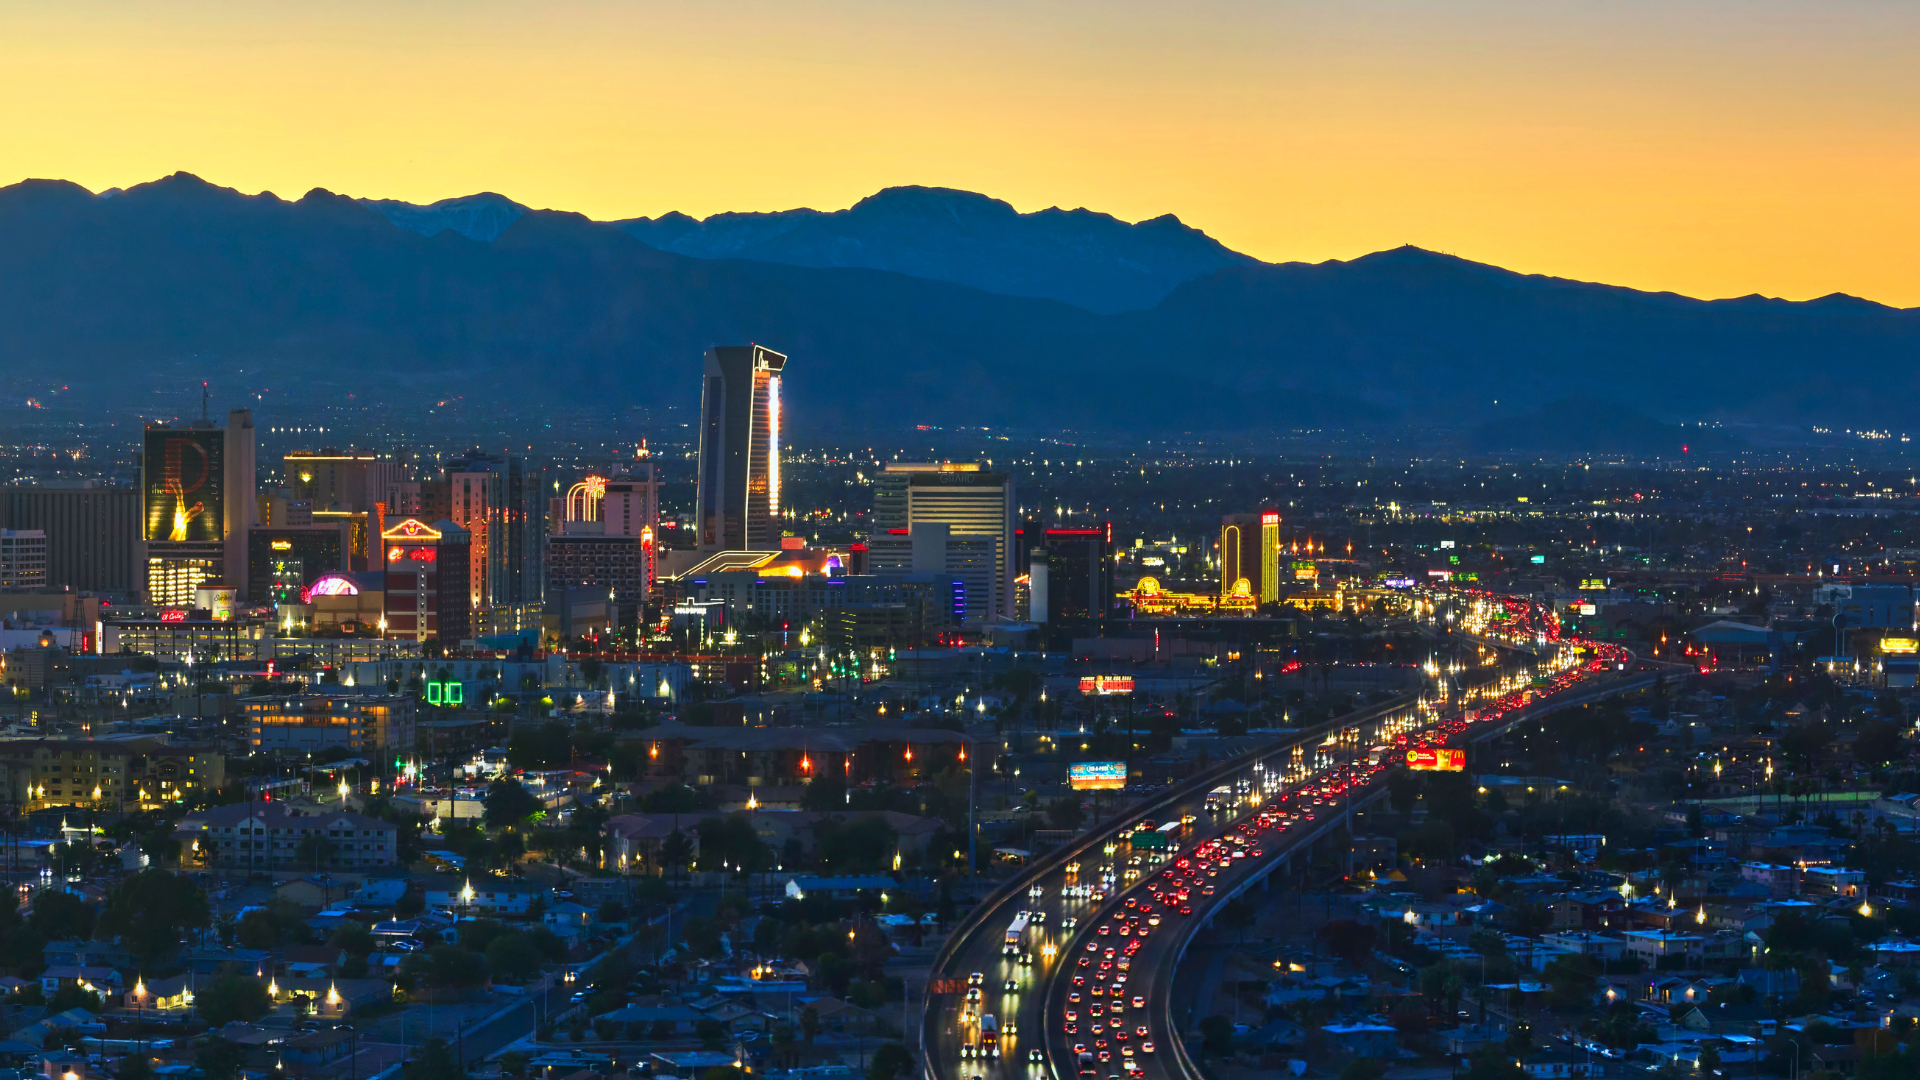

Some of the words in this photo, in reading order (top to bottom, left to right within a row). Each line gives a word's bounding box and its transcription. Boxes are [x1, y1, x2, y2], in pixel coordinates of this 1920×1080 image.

[940, 473, 975, 483] GRAND
[388, 549, 404, 560] El
[161, 613, 168, 621] El
[168, 612, 185, 621] Cortez
